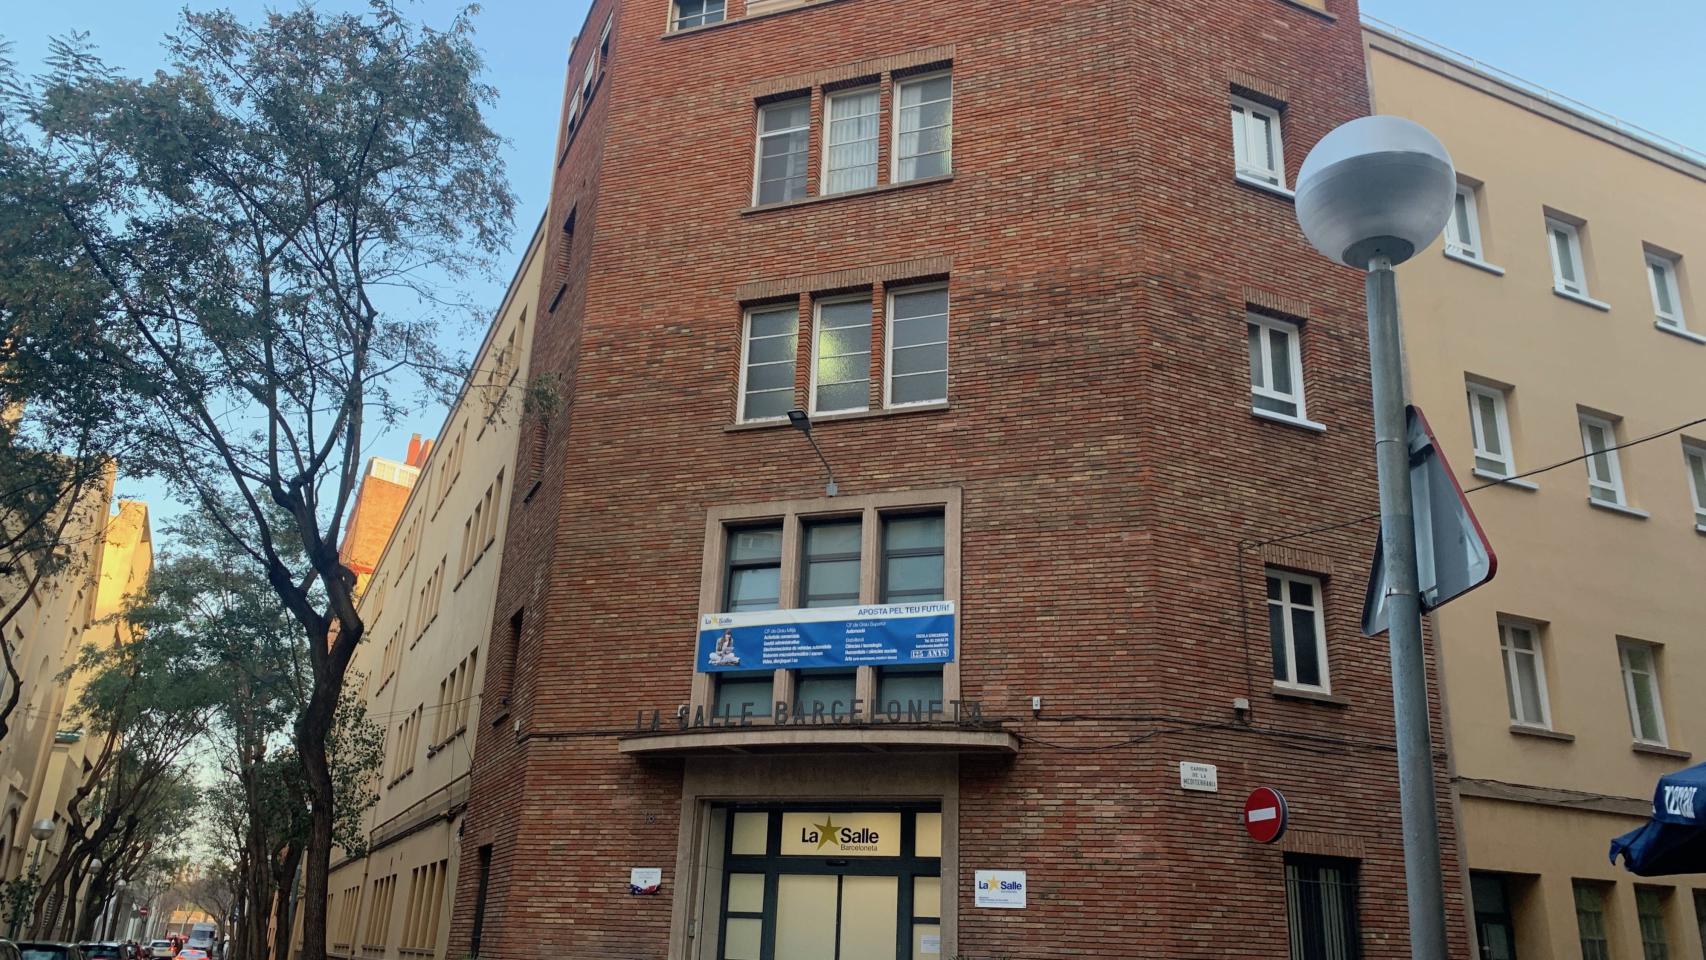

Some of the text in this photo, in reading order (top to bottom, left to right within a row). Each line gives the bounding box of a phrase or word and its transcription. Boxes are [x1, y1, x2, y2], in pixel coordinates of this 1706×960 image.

[858, 607, 888, 616] APOSTA
[889, 606, 903, 614] PEL
[905, 605, 920, 614] TEU
[678, 702, 755, 731] SALLE
[774, 698, 984, 727] BARCELONETA
[801, 827, 879, 844] La Salle
[978, 880, 1022, 890] La Salle
